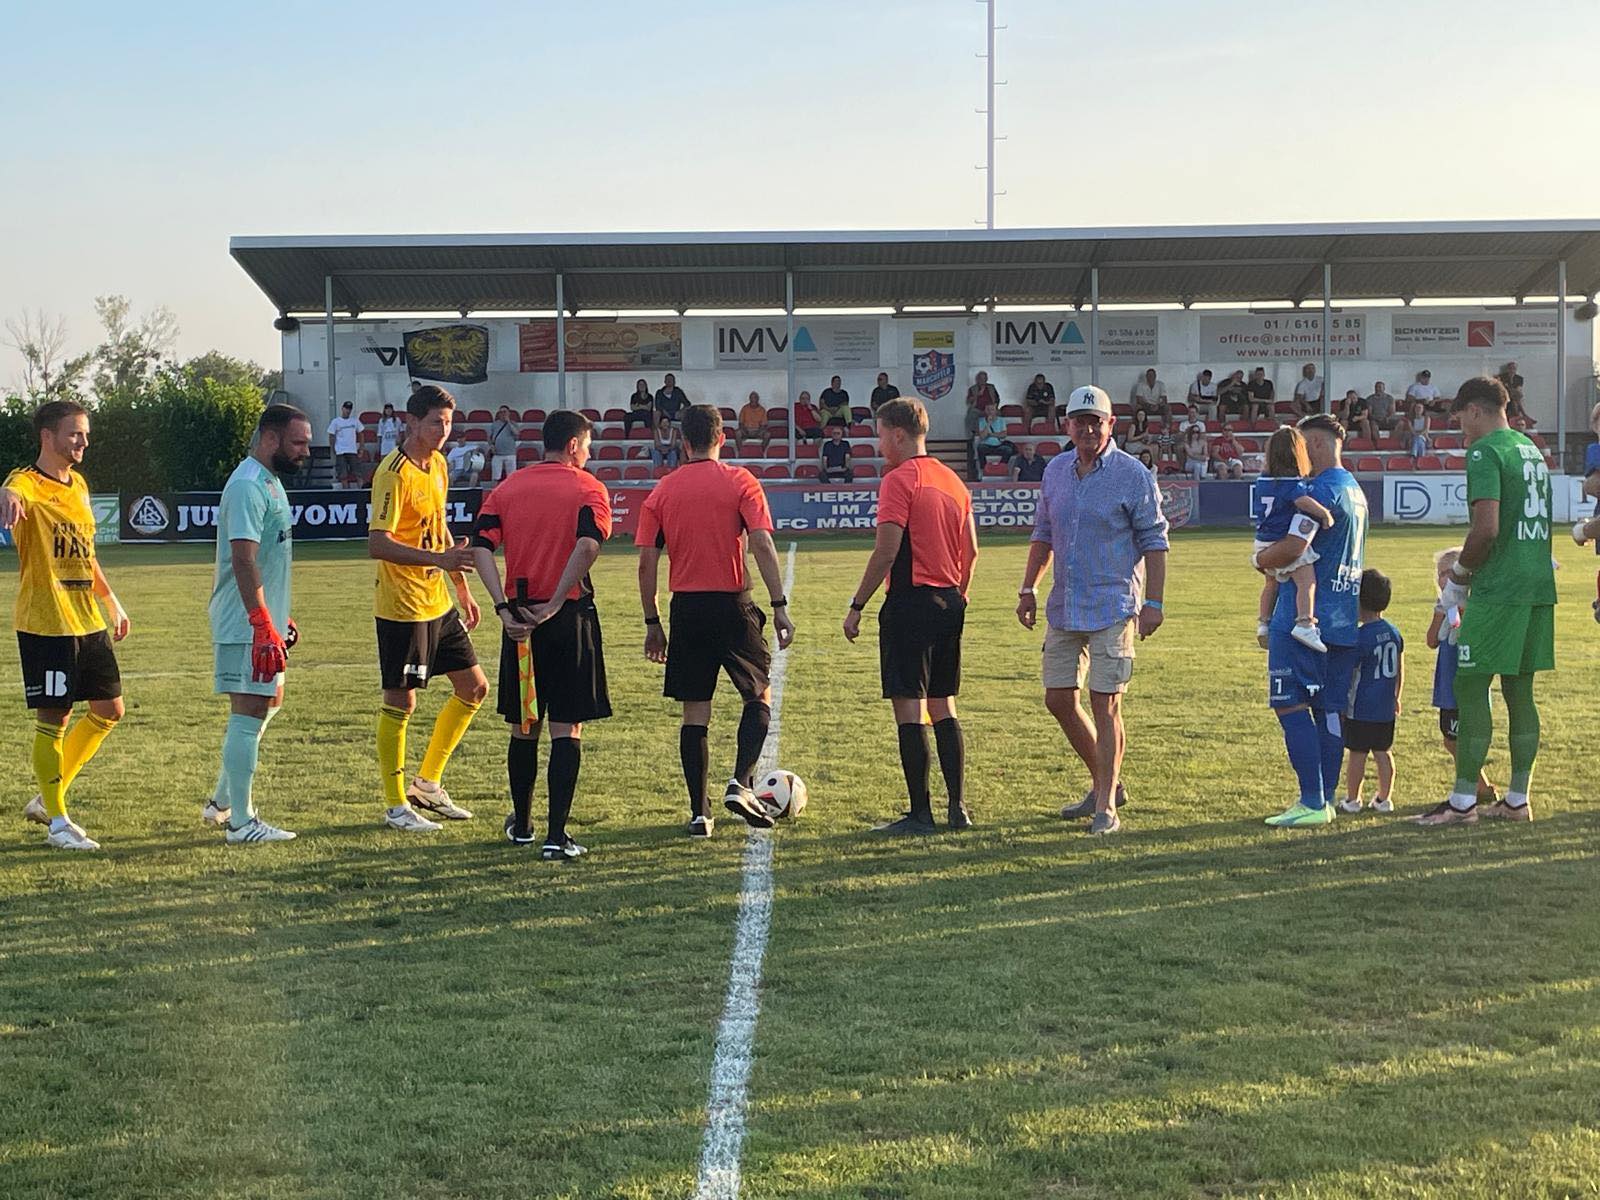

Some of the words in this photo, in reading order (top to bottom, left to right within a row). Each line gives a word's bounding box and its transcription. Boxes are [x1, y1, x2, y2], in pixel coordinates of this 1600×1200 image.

[1264, 320, 1279, 329] 01
[1295, 320, 1319, 329] 616
[1345, 319, 1361, 329] 85
[1394, 327, 1459, 335] SCHMITZER
[1236, 347, 1361, 357] www.schmiter.at
[832, 505, 859, 515] IM
[1260, 496, 1275, 518] 7
[777, 518, 808, 529] FC
[1374, 641, 1398, 679] 10
